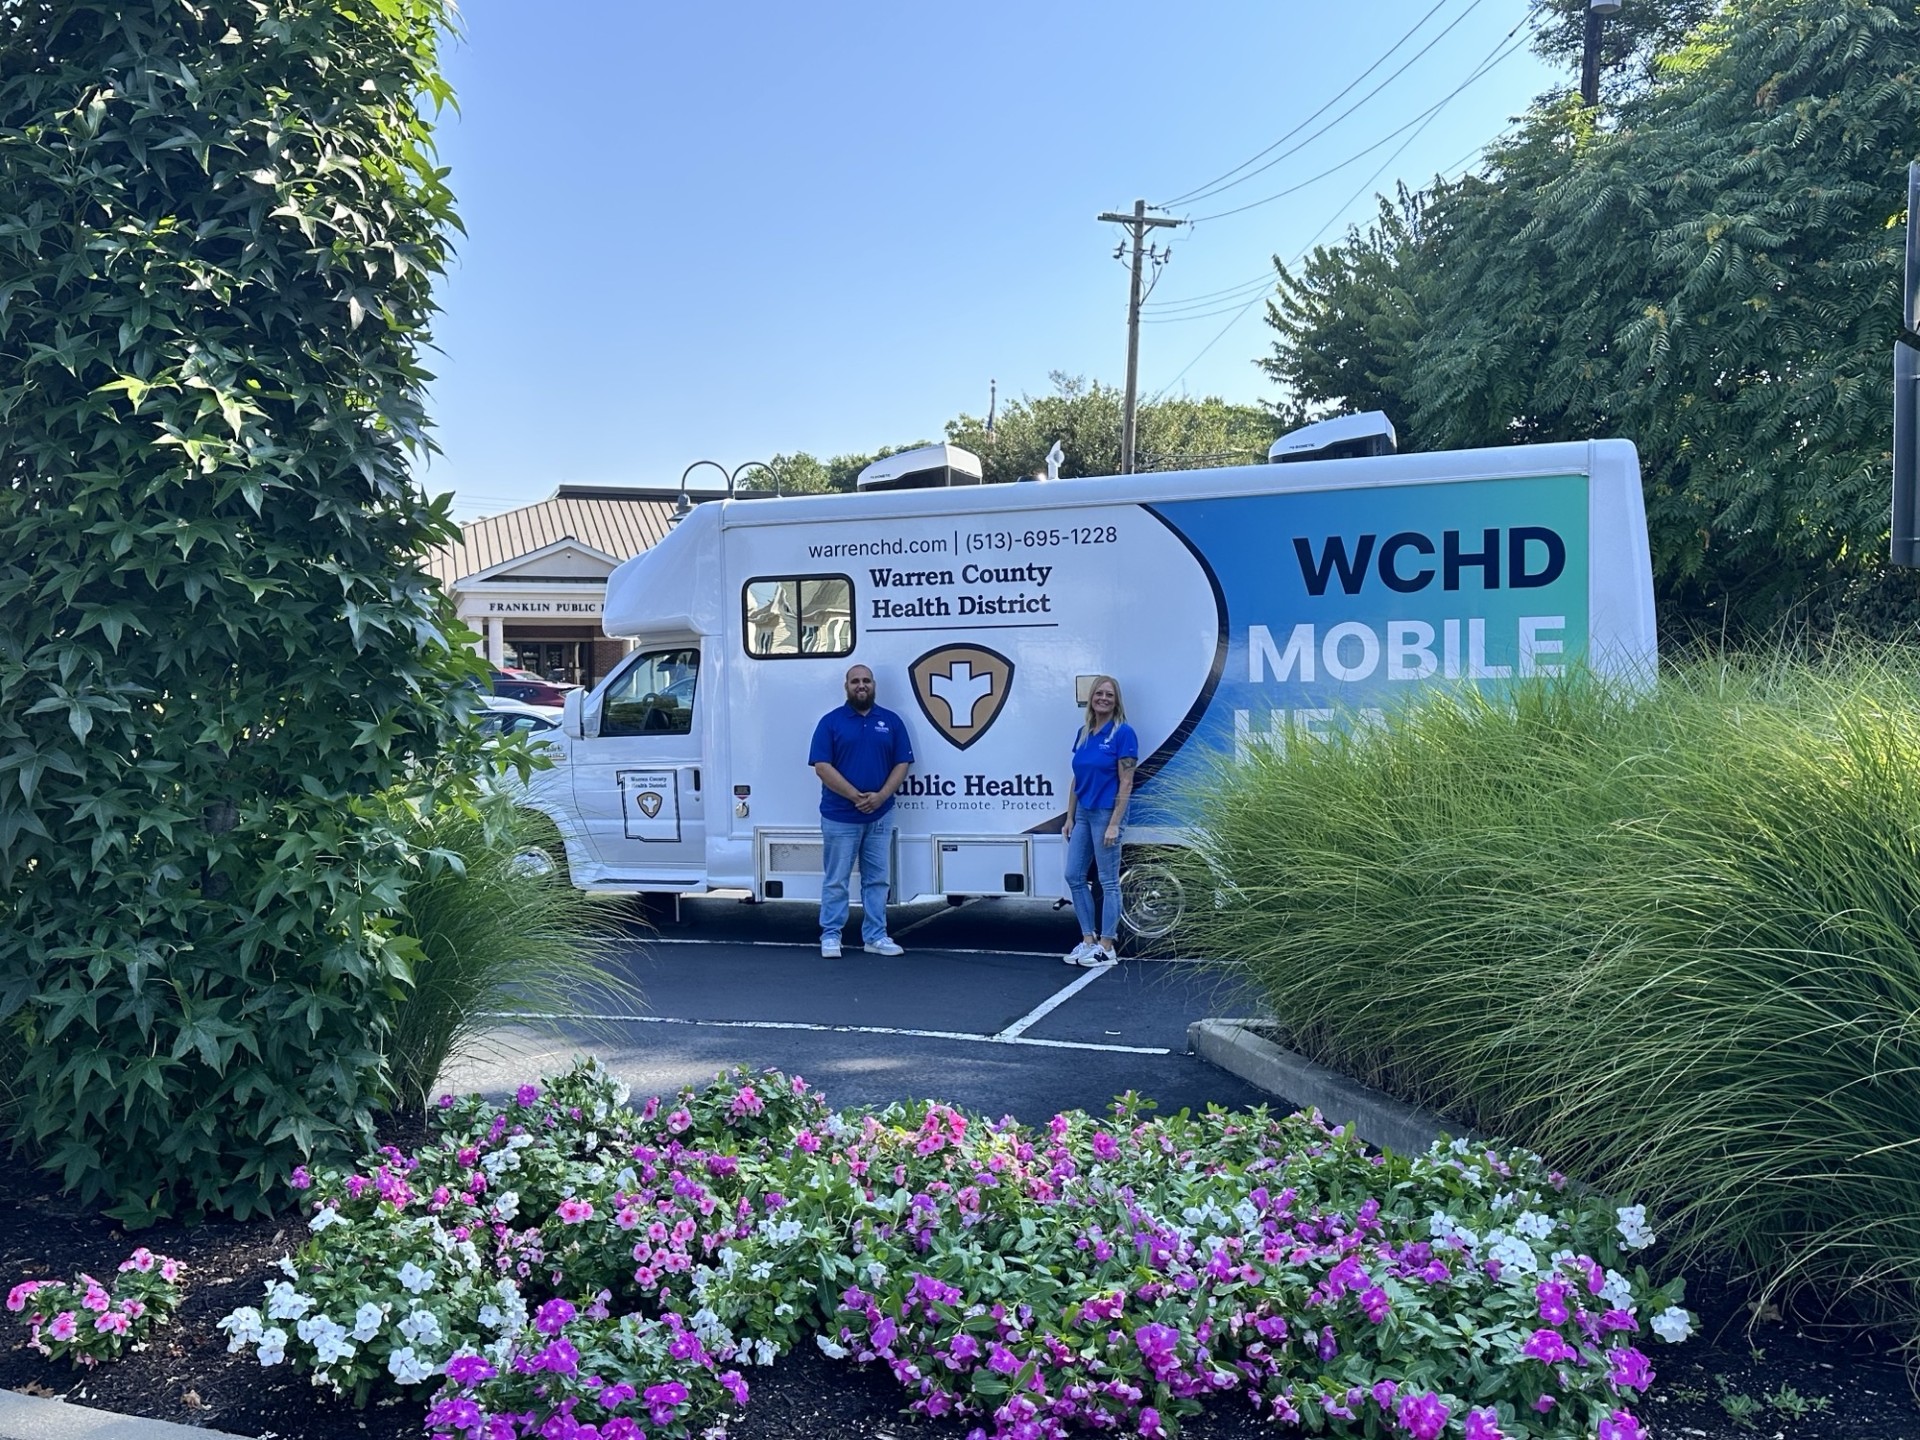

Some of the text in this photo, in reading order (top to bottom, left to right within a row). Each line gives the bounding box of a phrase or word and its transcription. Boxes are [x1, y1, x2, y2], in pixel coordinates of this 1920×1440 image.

[809, 526, 1118, 559] warrenchd.com (513)-695-1228
[1292, 526, 1567, 597] WCHD
[869, 562, 1053, 588] Warren County
[489, 603, 550, 612] FRANKLIN
[556, 603, 596, 612] PUBLIC
[872, 593, 1052, 618] Health District
[1248, 615, 1566, 683] MOBILE
[894, 773, 1055, 797] ublic Health
[935, 799, 996, 811] Promote.
[1001, 799, 1057, 811] Protect.
